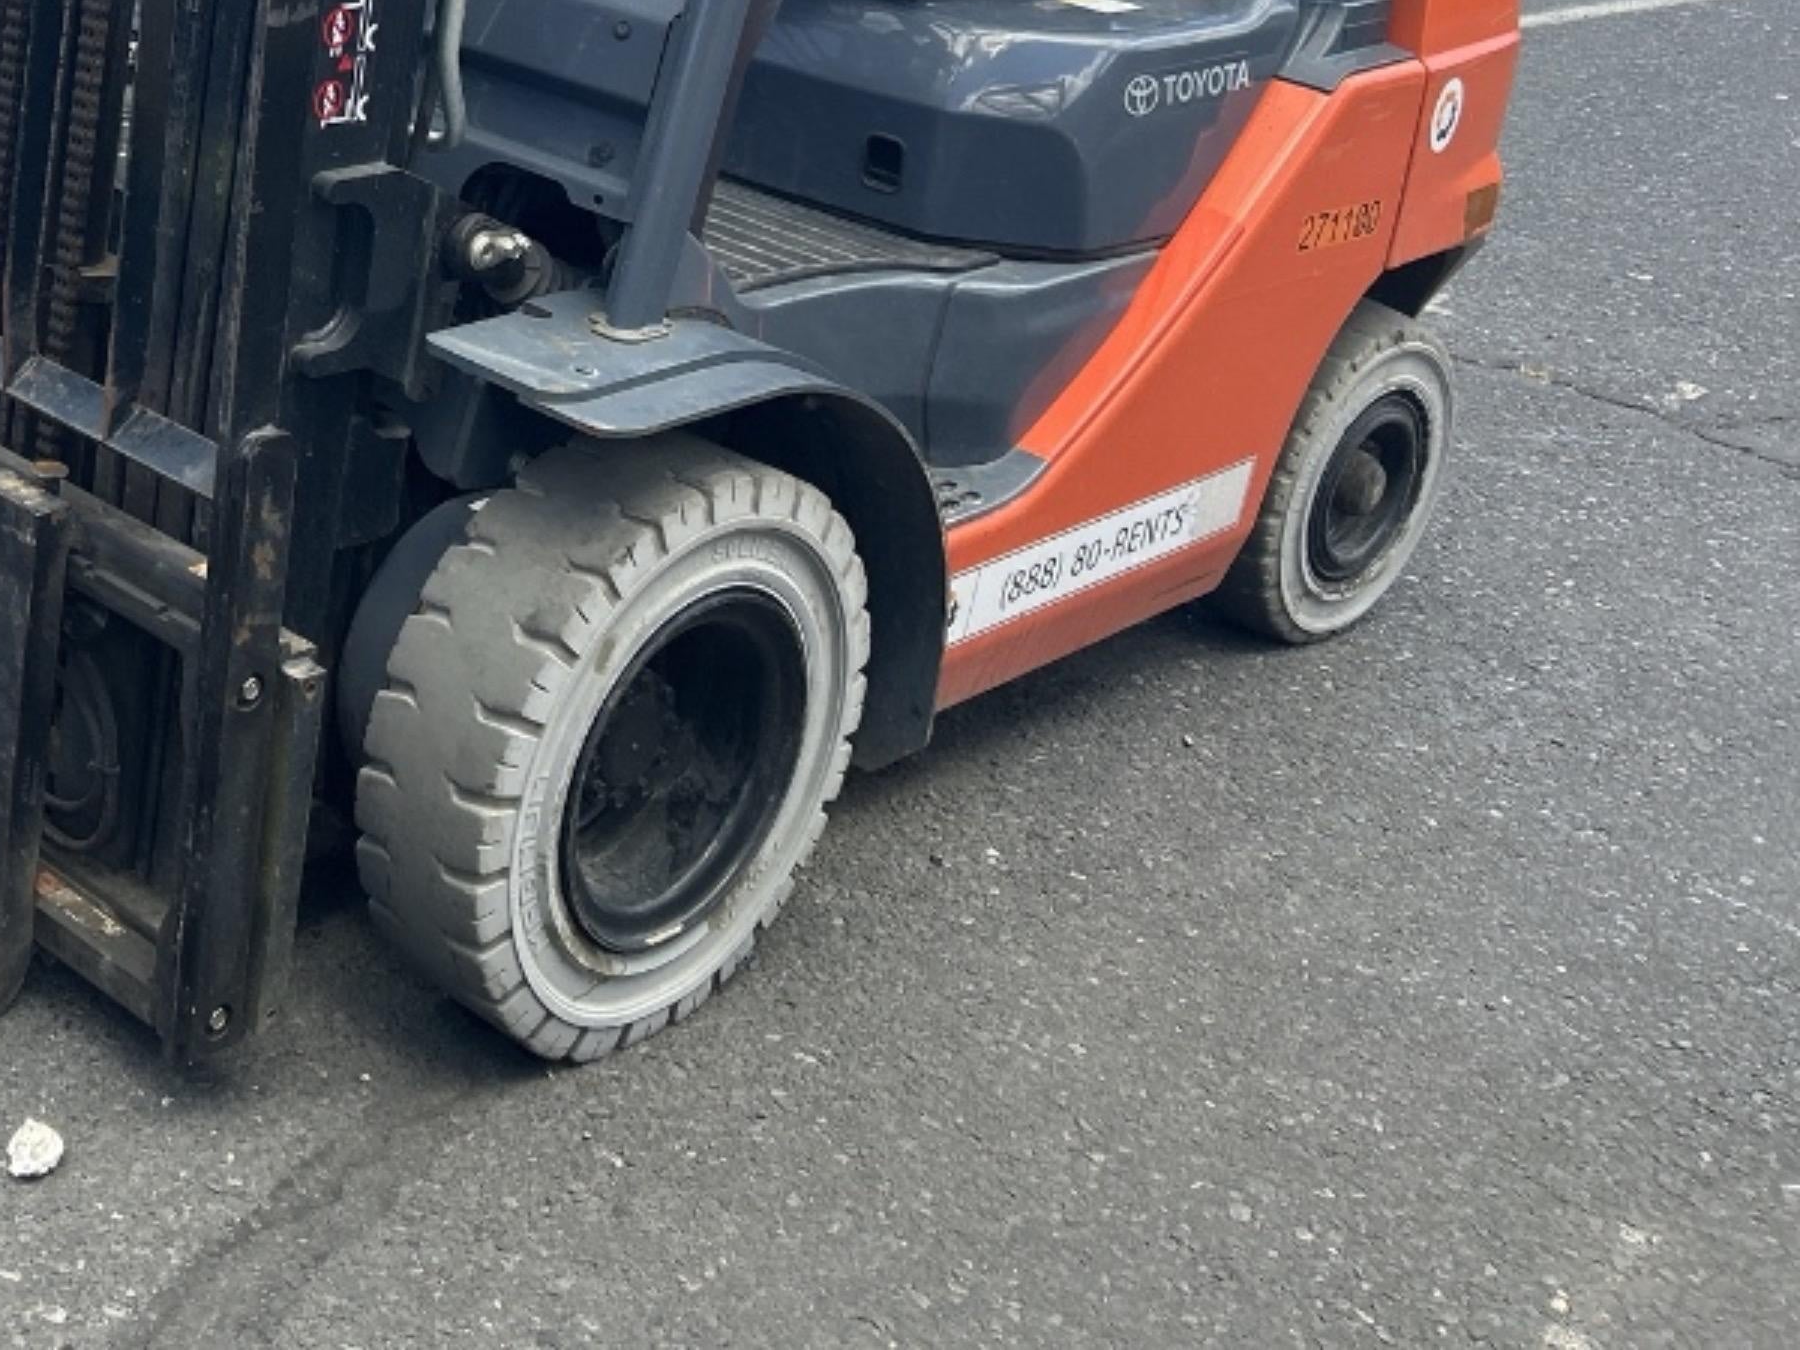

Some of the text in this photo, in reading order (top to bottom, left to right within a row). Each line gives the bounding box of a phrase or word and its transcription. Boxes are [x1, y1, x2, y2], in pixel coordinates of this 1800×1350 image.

[1162, 59, 1251, 106] TOYOTA
[1000, 504, 1186, 611] (888) 80-RENTS
